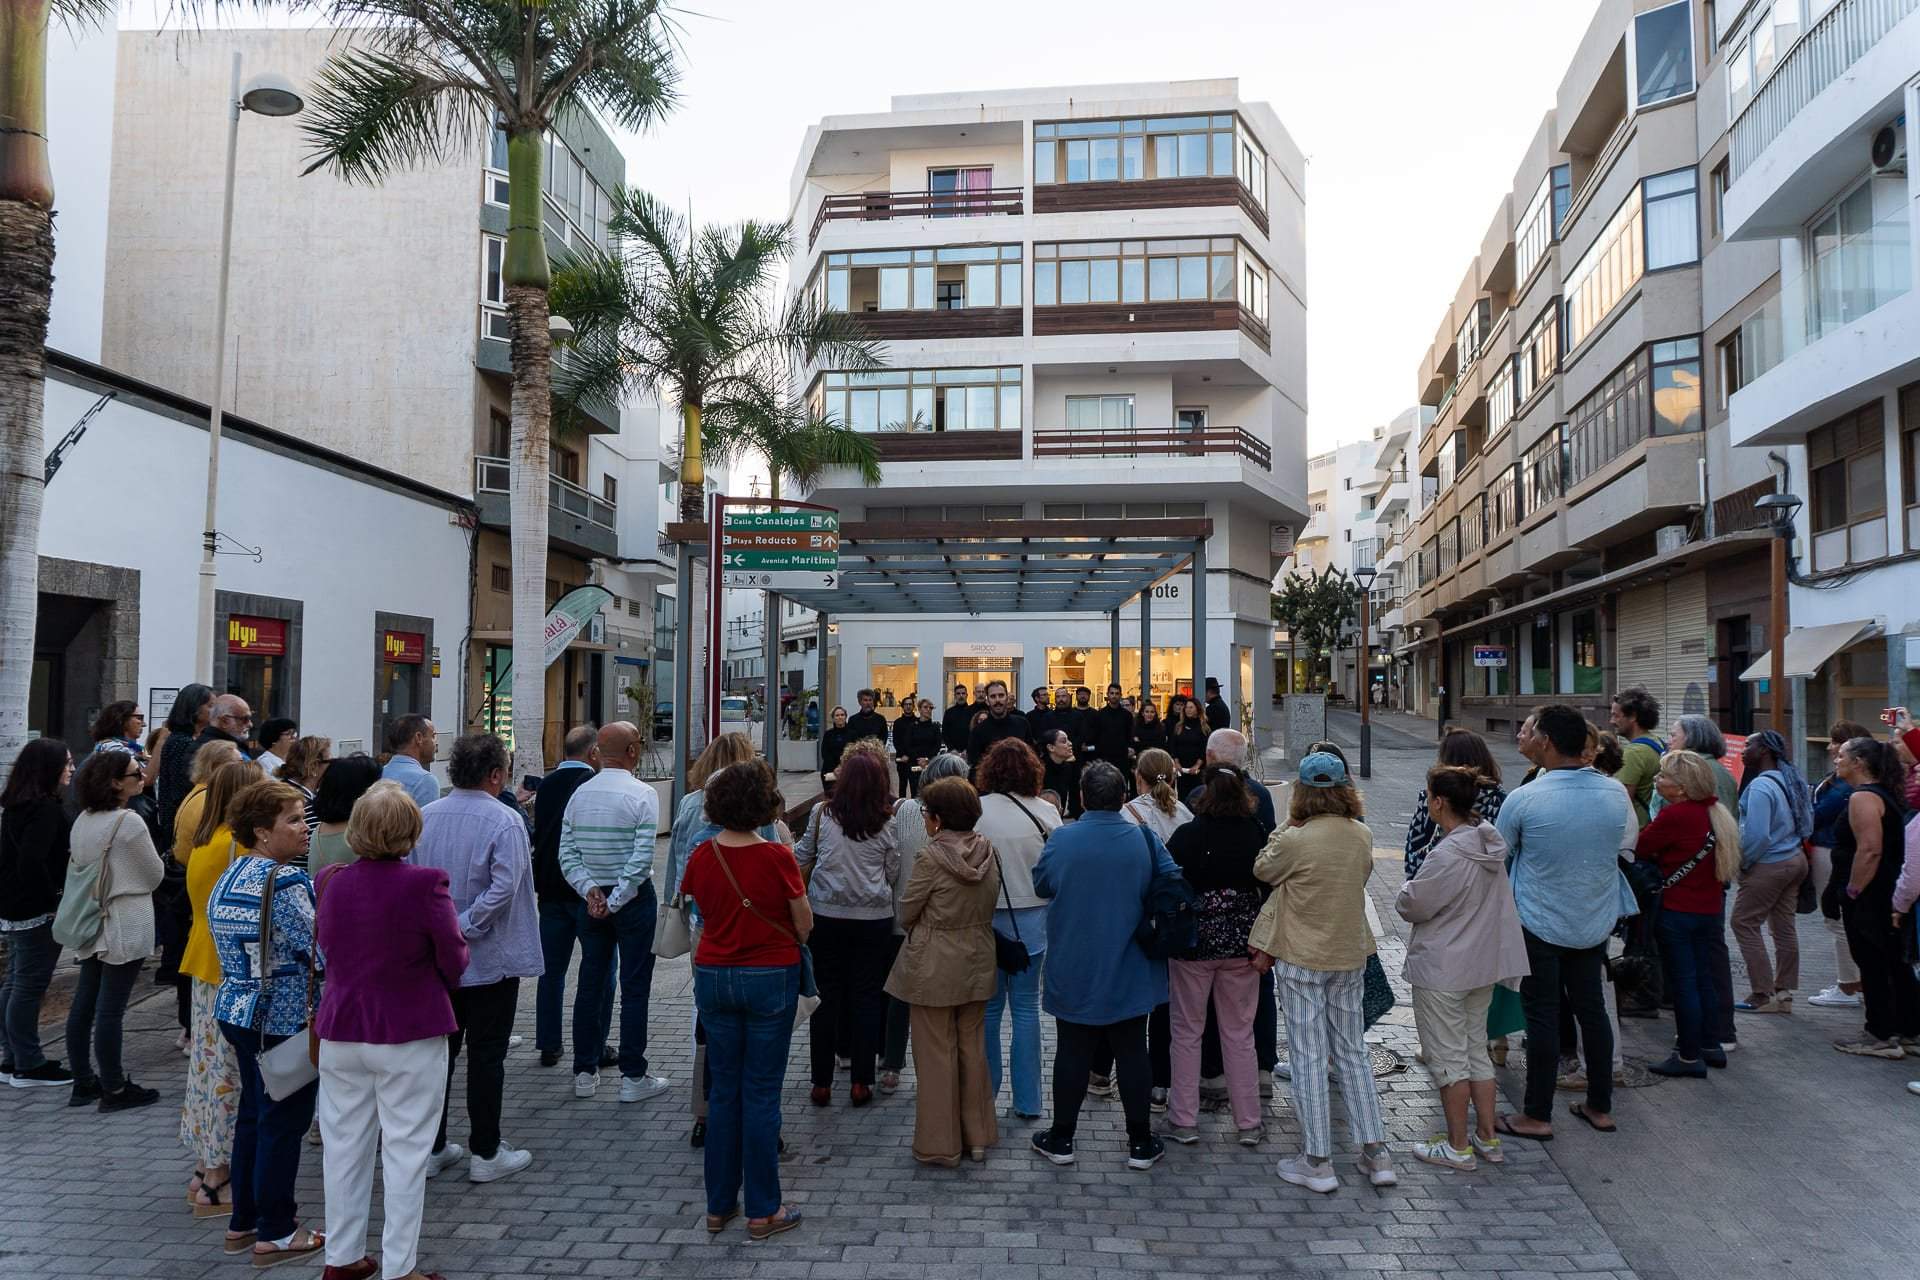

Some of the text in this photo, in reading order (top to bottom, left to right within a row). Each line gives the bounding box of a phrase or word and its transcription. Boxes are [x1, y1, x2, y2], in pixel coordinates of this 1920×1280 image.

[755, 516, 805, 527] Canalejas
[733, 535, 797, 545] Playa Reducto
